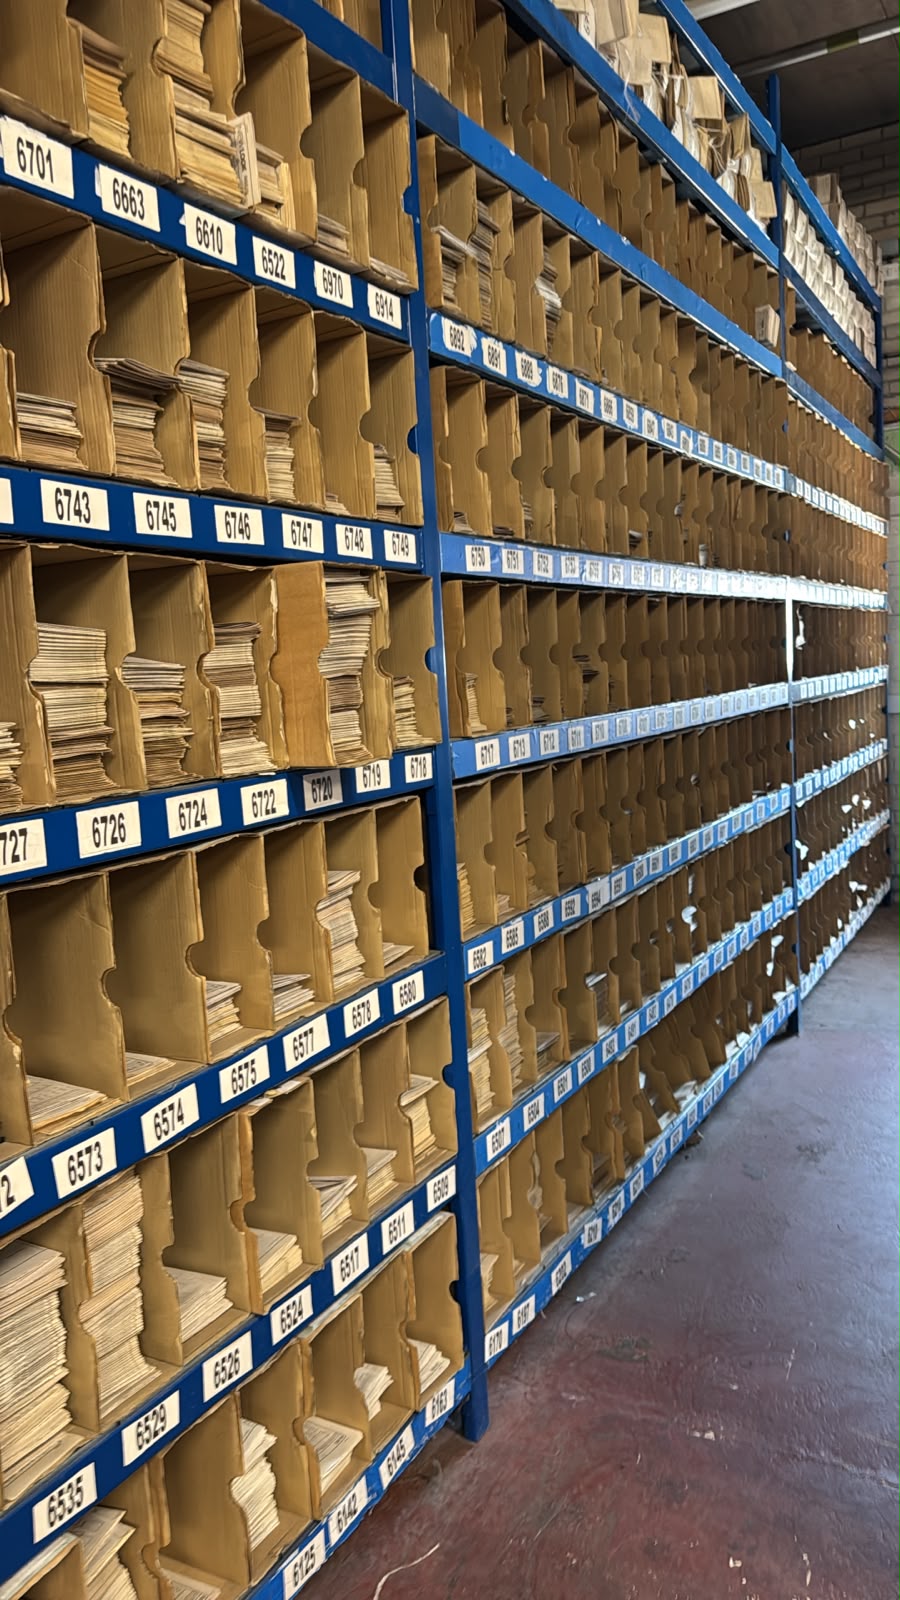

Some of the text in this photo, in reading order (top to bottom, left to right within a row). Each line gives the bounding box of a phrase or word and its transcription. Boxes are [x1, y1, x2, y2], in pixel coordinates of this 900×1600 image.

[16, 136, 54, 184] 6701
[112, 177, 146, 221] 6663
[195, 215, 224, 256] 6610
[261, 245, 287, 282] 6522
[321, 271, 344, 300] 6970
[374, 291, 395, 322] 6914
[449, 324, 465, 352] 6892
[487, 344, 501, 370] 6891
[54, 486, 91, 525] 6743
[145, 499, 177, 533] 6745
[224, 510, 251, 541] 6746
[290, 519, 313, 548] 6747
[344, 526, 365, 553] 6748
[391, 532, 410, 557] 6749
[470, 546, 486, 568] 6750
[506, 550, 519, 570] 6751
[480, 743, 494, 766] 6717
[513, 737, 526, 759] 6713
[543, 732, 555, 752] 6712
[362, 762, 382, 789] 6719
[410, 755, 427, 779] 6718
[251, 787, 277, 818] 6722
[311, 774, 333, 804] 6720
[178, 797, 208, 831] 6724
[91, 812, 127, 848] 6726
[0, 827, 28, 866] 727
[472, 946, 487, 970] 6582
[398, 979, 417, 1008] 6580
[351, 999, 372, 1030] 6578
[292, 1026, 315, 1062] 6577
[230, 1057, 257, 1095] 6575
[153, 1097, 185, 1142] 6574
[67, 1140, 104, 1187] 6573
[432, 1174, 450, 1204] 6509
[387, 1211, 407, 1246] 6511
[339, 1245, 360, 1283] 6517
[280, 1293, 304, 1335] 6524
[489, 1328, 503, 1357] 6170
[213, 1347, 241, 1389] 6526
[431, 1391, 448, 1420] 6163
[135, 1402, 168, 1452] 6529
[386, 1438, 407, 1477] 6145
[47, 1474, 84, 1529] 6535
[336, 1492, 359, 1535] 6142
[293, 1543, 317, 1588] 6125
